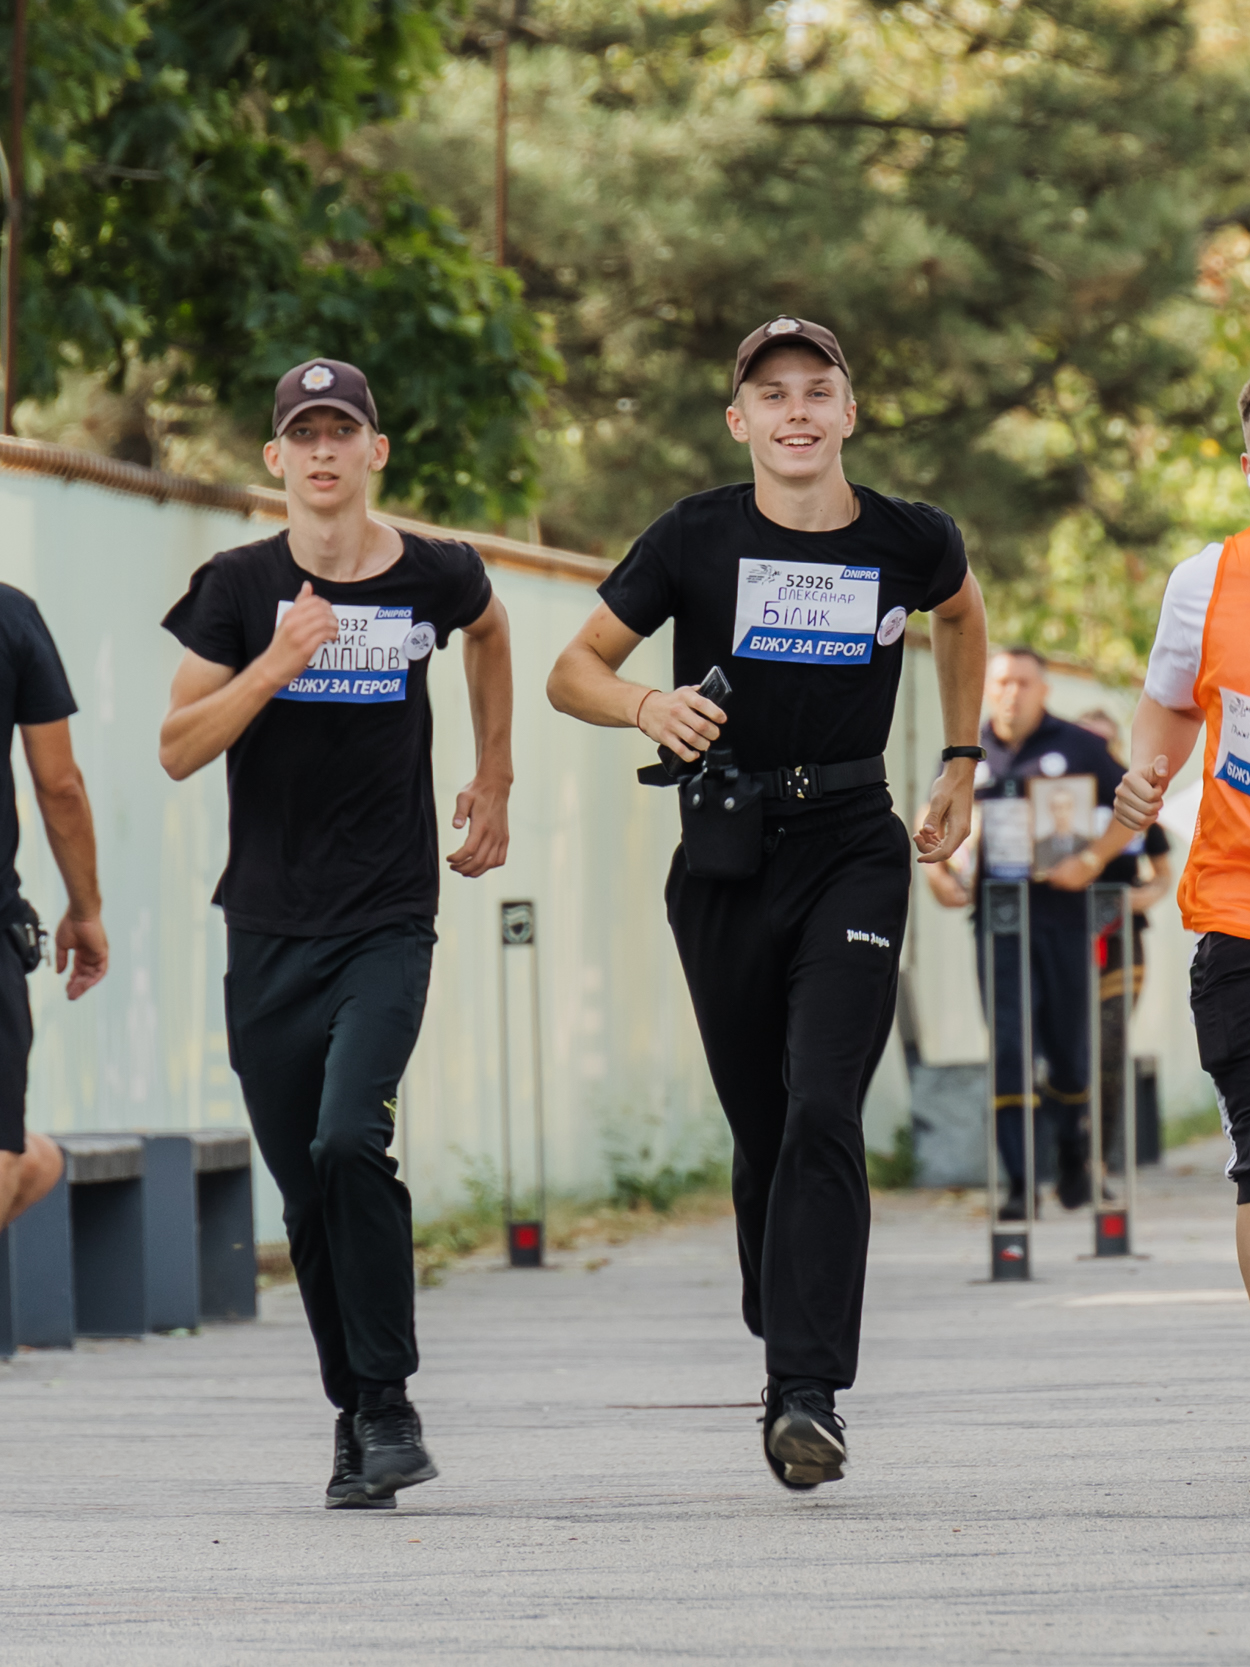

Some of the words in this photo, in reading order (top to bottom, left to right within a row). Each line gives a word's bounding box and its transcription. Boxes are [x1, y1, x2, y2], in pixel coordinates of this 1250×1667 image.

[786, 574, 834, 590] 52926
[843, 569, 879, 581] DNIPRO
[377, 609, 412, 619] DNIPRO
[338, 618, 368, 632] 932
[750, 636, 792, 653] БІЖУ
[792, 639, 813, 654] ЗА
[815, 640, 867, 657] ГЕРОЯ
[306, 647, 400, 672] ЛІПЦОВ
[288, 678, 329, 693] БІЖУ
[329, 679, 350, 694] ЗА
[353, 678, 402, 695] ГЕРОЯ
[846, 929, 870, 943] Palm
